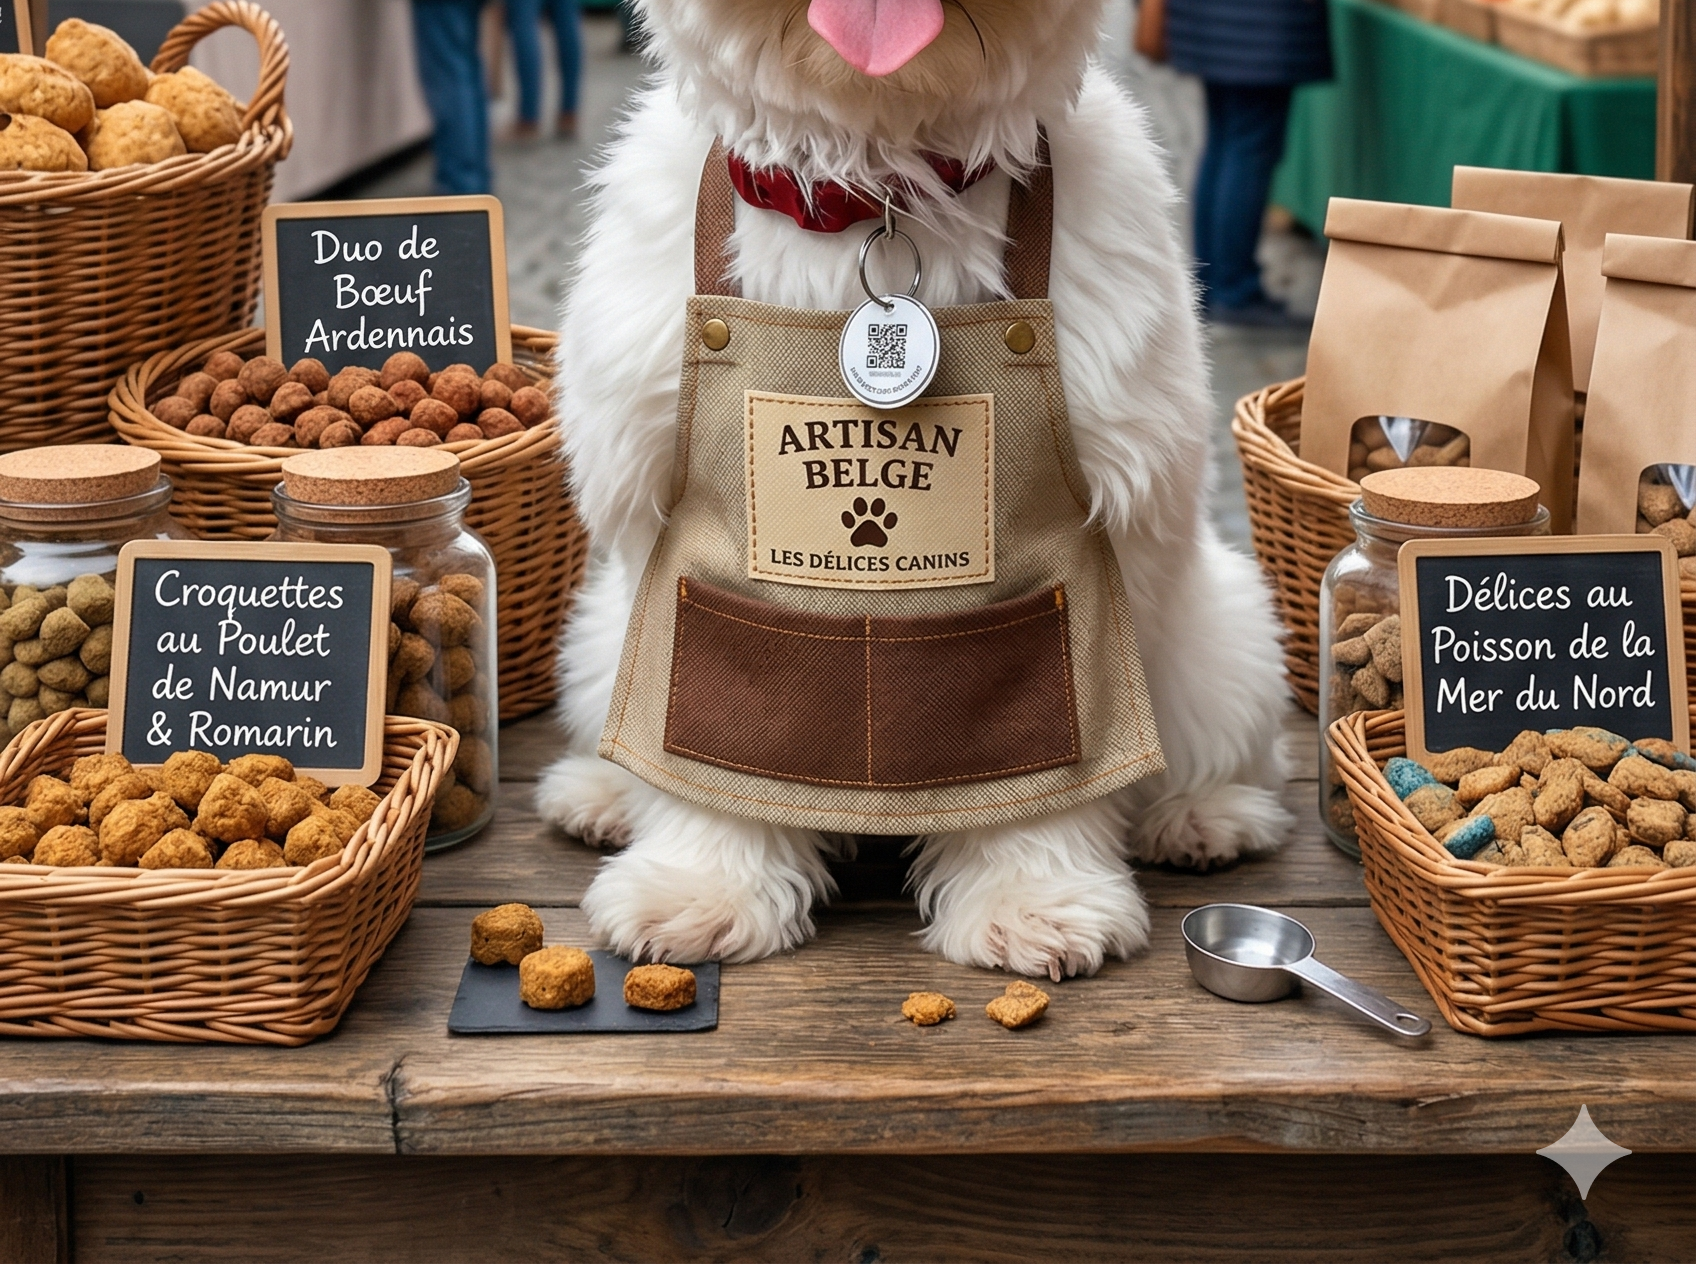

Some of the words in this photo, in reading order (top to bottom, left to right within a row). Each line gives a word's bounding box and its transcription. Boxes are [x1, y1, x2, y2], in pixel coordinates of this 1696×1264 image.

[310, 229, 383, 265] Duo
[398, 224, 440, 261] de
[332, 268, 433, 317] Bœuf
[304, 315, 474, 354] Ardennais
[778, 419, 963, 458] ARTISAN
[802, 458, 934, 491] BELGE
[770, 548, 804, 567] LES
[809, 550, 890, 572] DÉLICES
[895, 551, 970, 571] CANINS
[154, 569, 344, 621] Croquettes
[1444, 571, 1572, 613] Délices
[1586, 586, 1633, 608] au
[156, 630, 202, 654] au
[217, 617, 331, 657] Poulet
[1431, 625, 1556, 664] Poisson
[1568, 621, 1609, 660] de
[1622, 619, 1655, 658] la
[152, 663, 194, 700] de
[209, 665, 332, 702] Namur
[1436, 676, 1504, 714] Mer
[1515, 673, 1560, 712] du
[1573, 669, 1656, 710] Nord
[146, 709, 172, 746] &
[188, 710, 338, 748] Romarin
